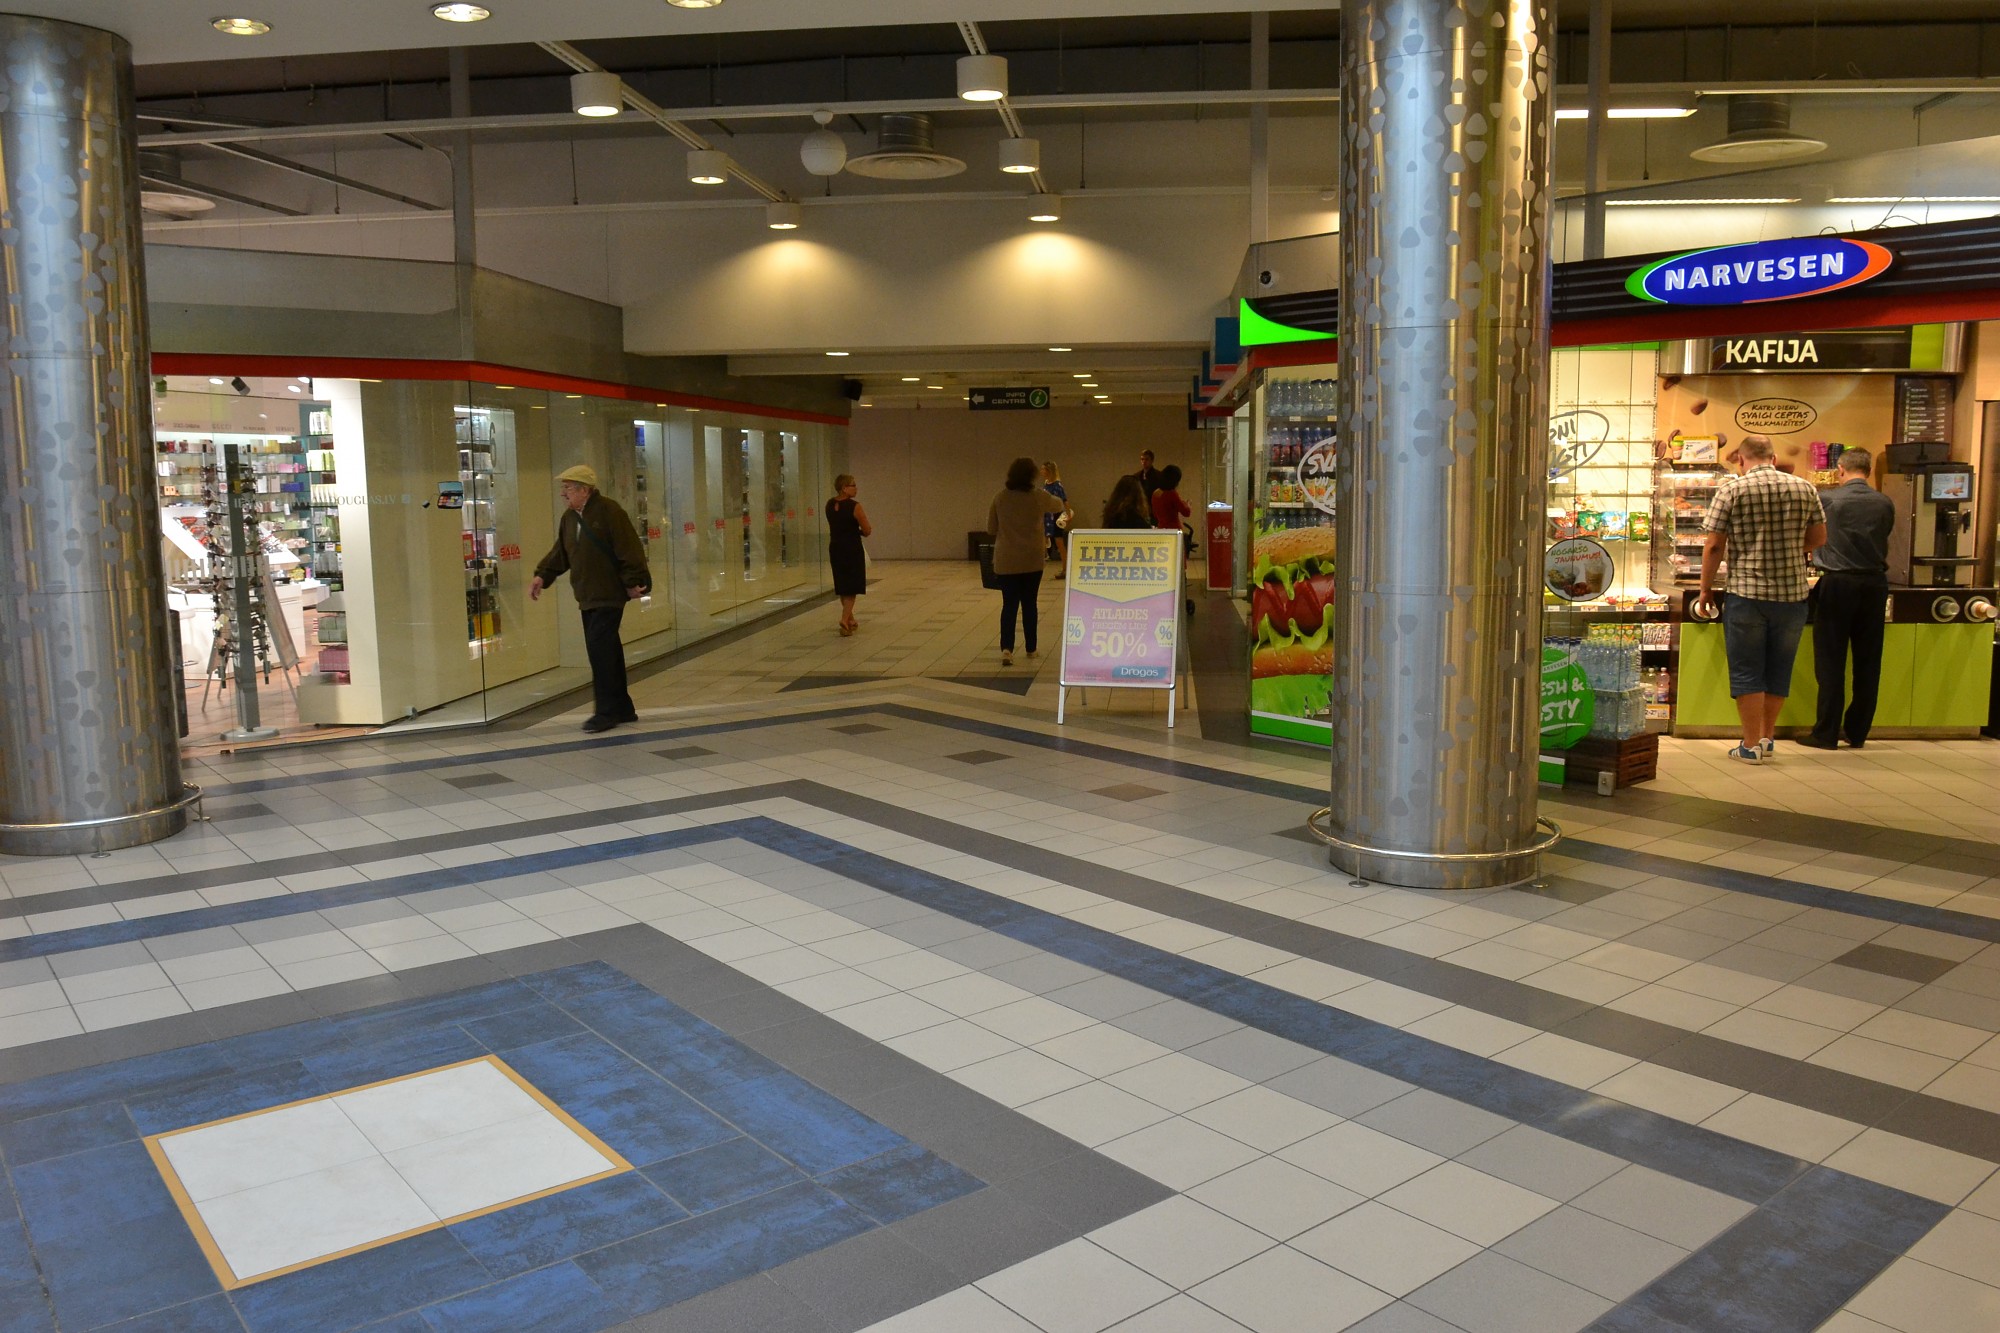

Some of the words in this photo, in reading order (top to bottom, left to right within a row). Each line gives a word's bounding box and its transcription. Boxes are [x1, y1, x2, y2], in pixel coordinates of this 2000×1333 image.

[1664, 252, 1844, 291] NARVESEN
[1725, 339, 1819, 364] KAFIJA
[1741, 411, 1772, 419] SVAIGI
[1774, 411, 1810, 419] CEPTAS
[1080, 546, 1169, 562] LIELAIS
[1079, 563, 1168, 582] ĶĒRIENS
[1092, 608, 1148, 620] ATLAIDES
[1090, 631, 1147, 658] 50%
[1121, 667, 1159, 677] Drogas
